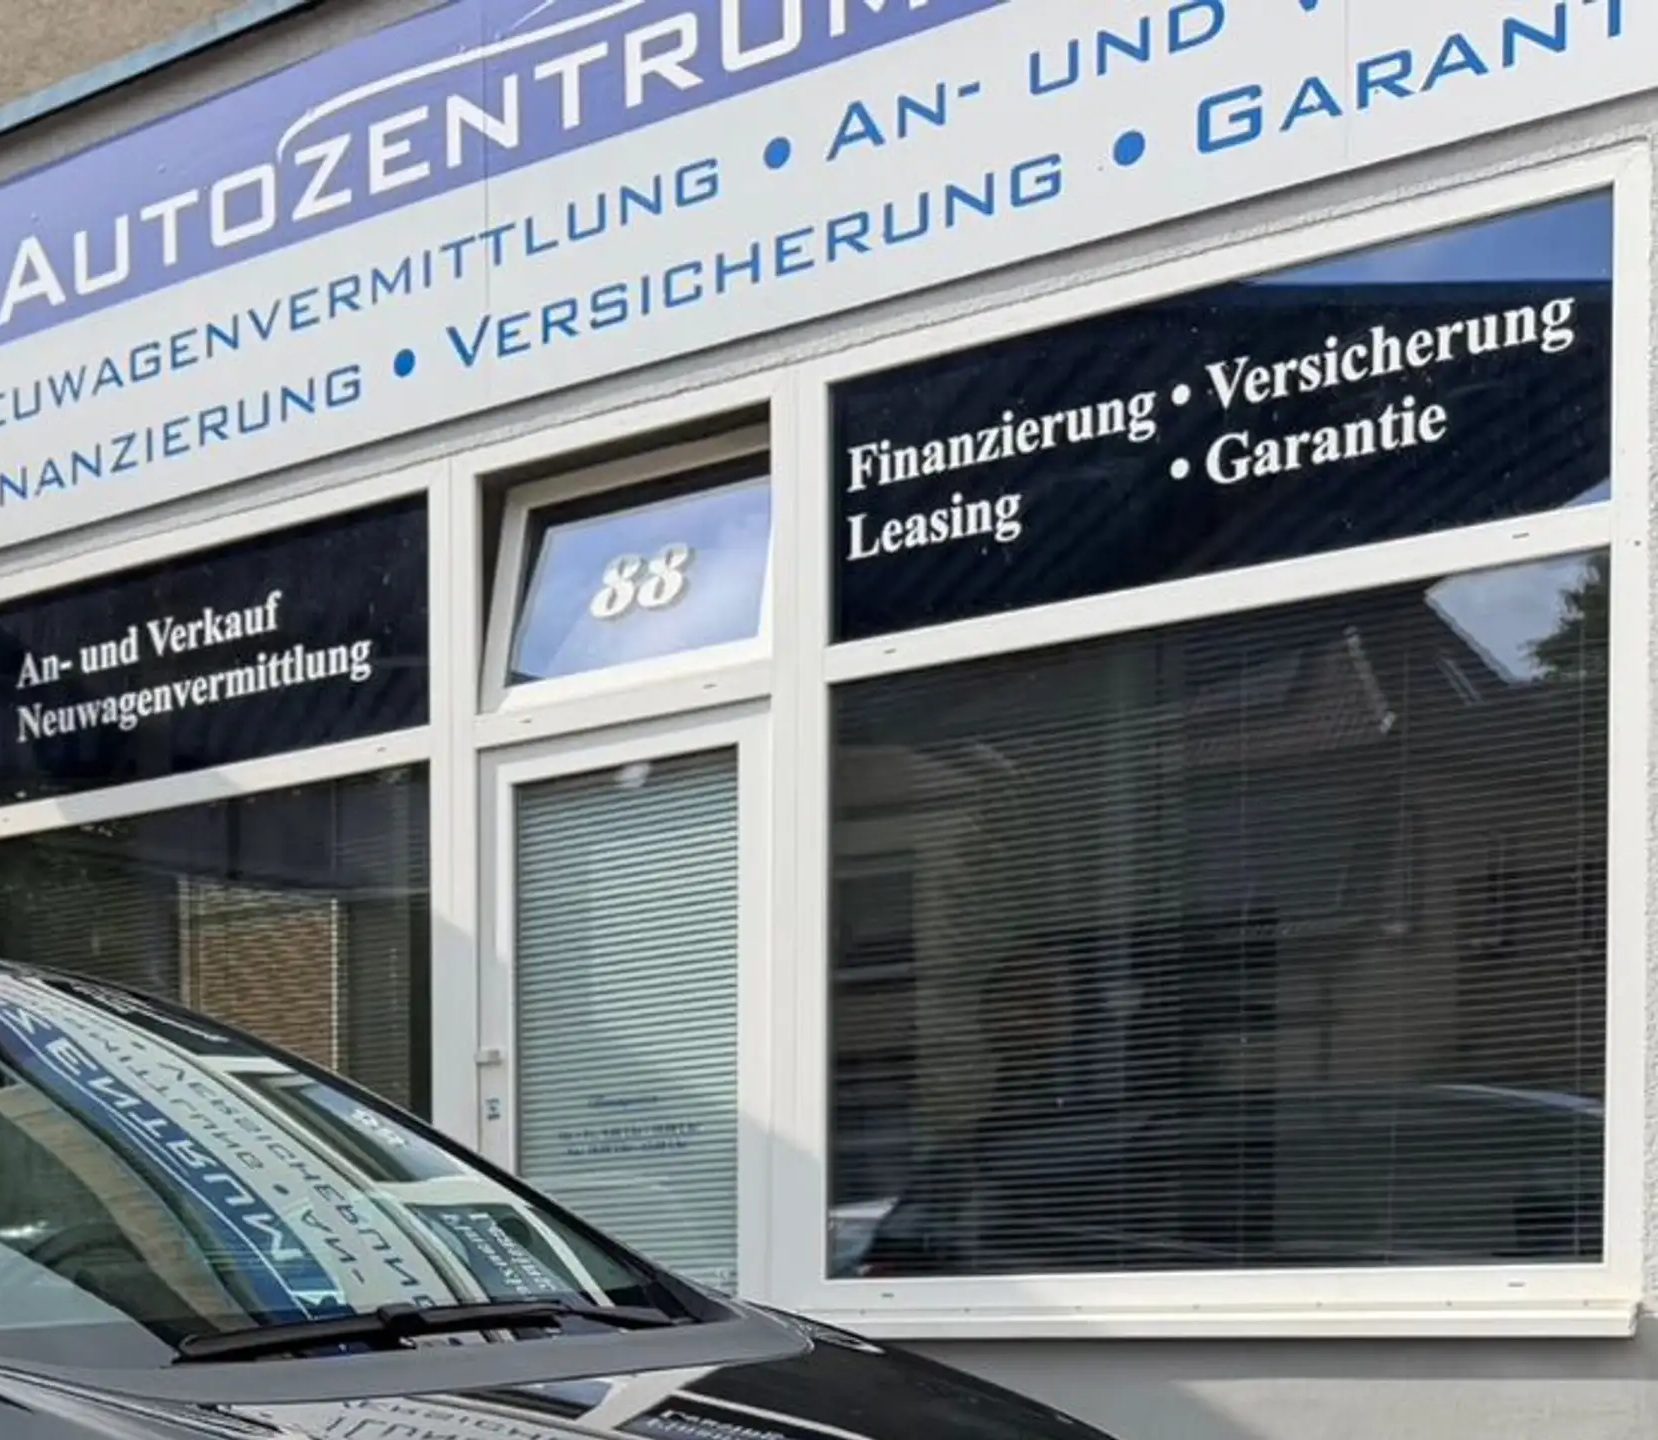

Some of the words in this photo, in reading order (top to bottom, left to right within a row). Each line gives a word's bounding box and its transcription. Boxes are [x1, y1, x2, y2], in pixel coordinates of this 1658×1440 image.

[826, 81, 980, 162] AN-
[1029, 0, 1225, 95] UND
[447, 153, 1062, 368] VERSICHERUNG
[848, 389, 1157, 492] Finanzierung
[1207, 296, 1576, 403] Versicherung
[848, 490, 1022, 561] Leasing
[1207, 398, 1447, 486] Garantie
[16, 652, 72, 690] An-
[80, 626, 139, 675] und
[147, 589, 283, 658] Verkauf
[590, 542, 689, 617] 88
[16, 639, 373, 743] Neuwagenvermittlung
